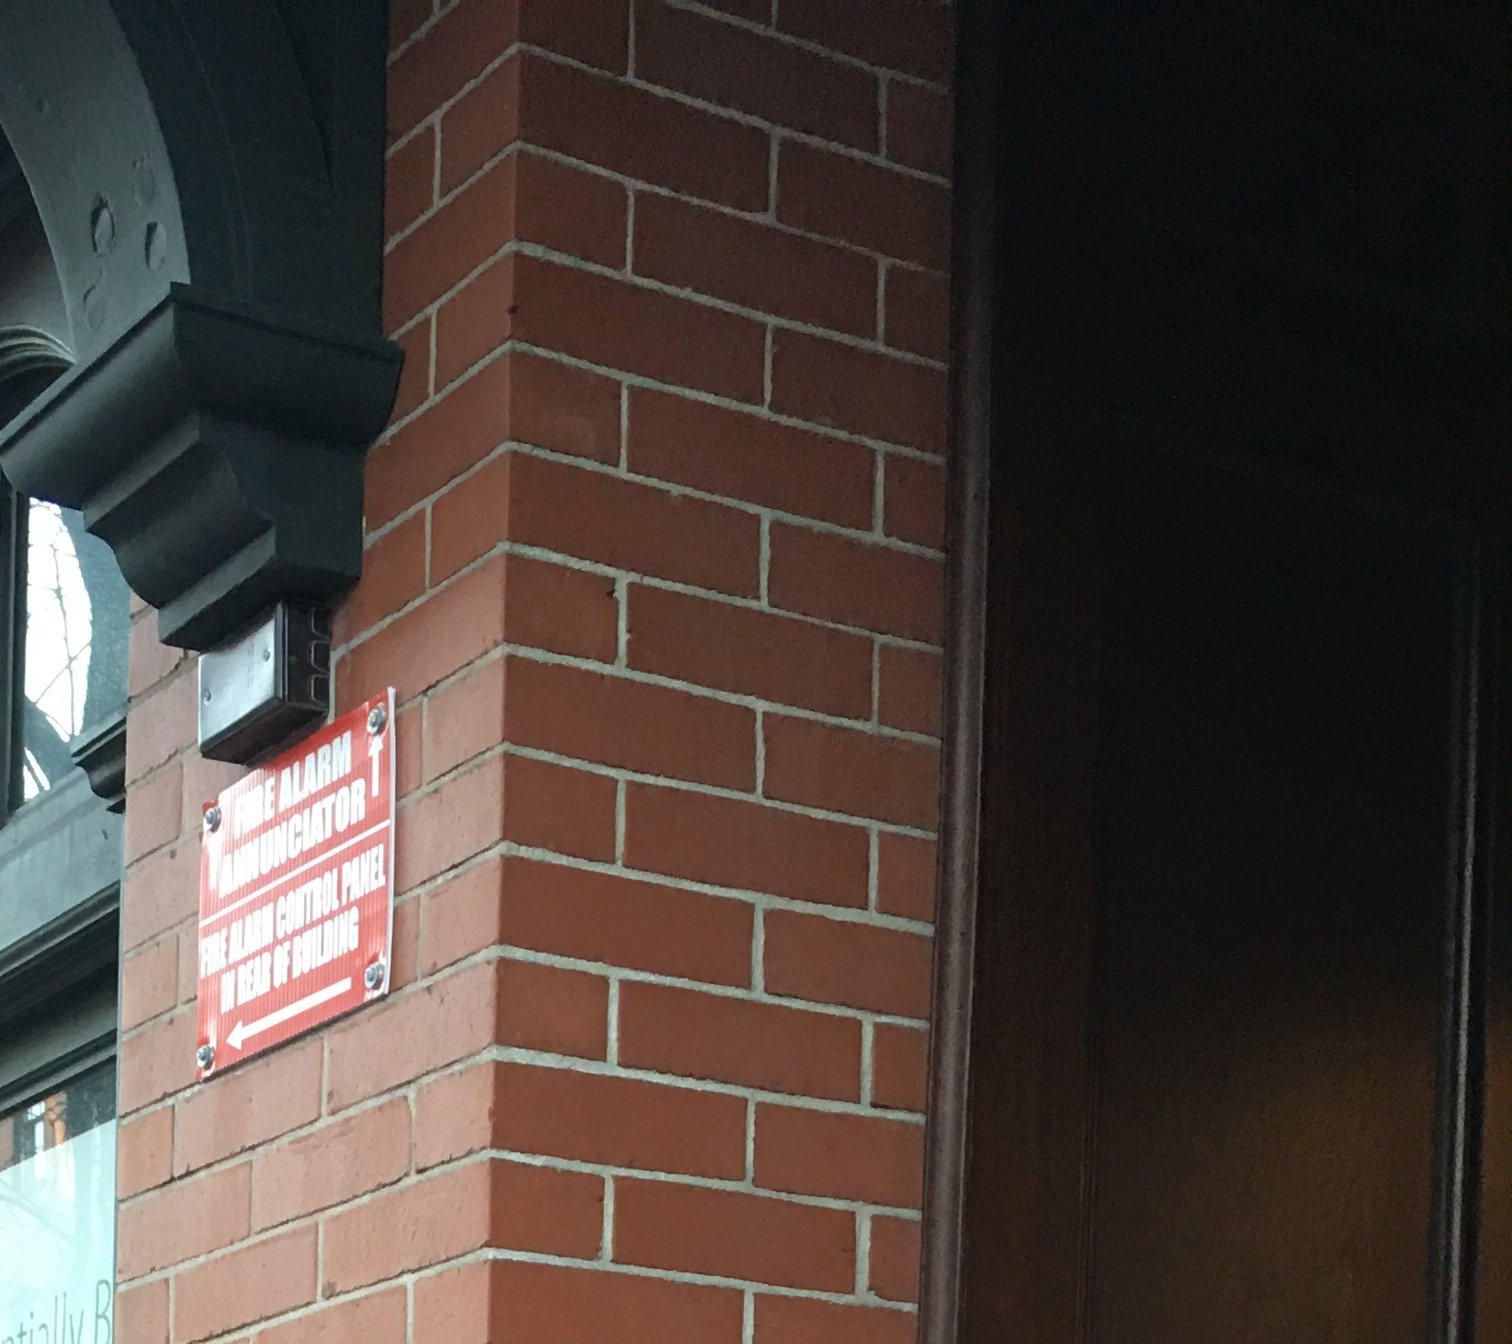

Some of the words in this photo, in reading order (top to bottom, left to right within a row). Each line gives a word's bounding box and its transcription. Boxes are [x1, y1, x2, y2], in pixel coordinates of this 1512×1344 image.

[279, 730, 353, 814] ALARM
[219, 777, 366, 898] ANNUNCIATOR
[200, 927, 228, 980] FIRE
[228, 902, 275, 964] ALARM
[276, 867, 339, 940] CONTROL
[341, 843, 386, 906] PANEL
[220, 968, 236, 1015] IN
[237, 951, 272, 1006] REAR
[273, 940, 291, 989] OF
[292, 906, 360, 980] BUILDING
